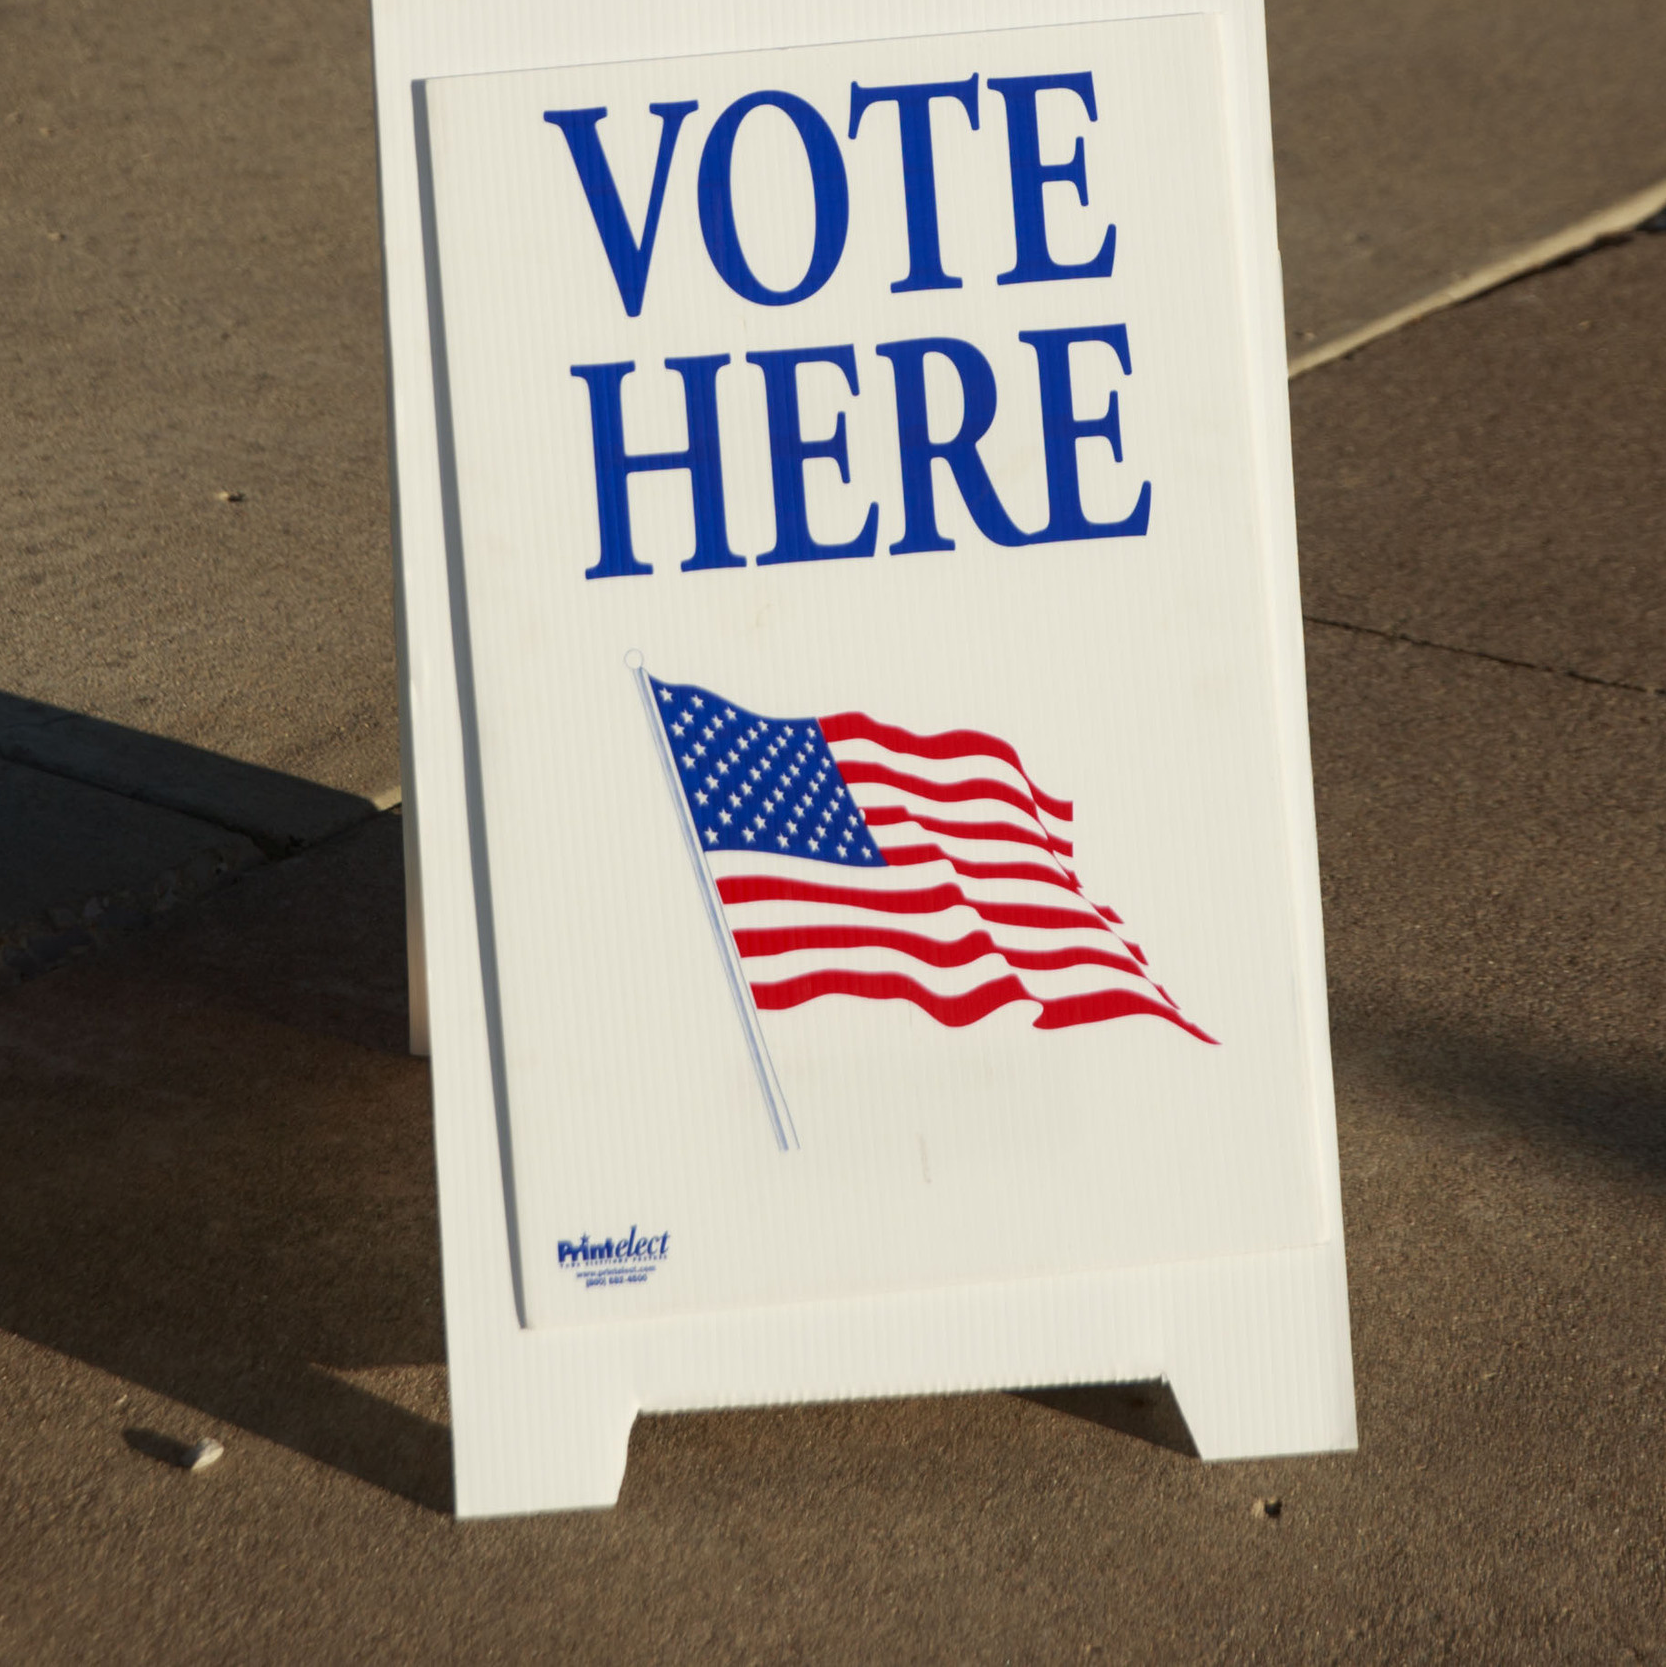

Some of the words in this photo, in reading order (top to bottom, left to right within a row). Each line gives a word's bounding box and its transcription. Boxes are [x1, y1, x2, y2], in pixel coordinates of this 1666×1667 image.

[543, 71, 1117, 318] VOTE
[570, 323, 1152, 580] HERE
[557, 1224, 671, 1263] Printelect
